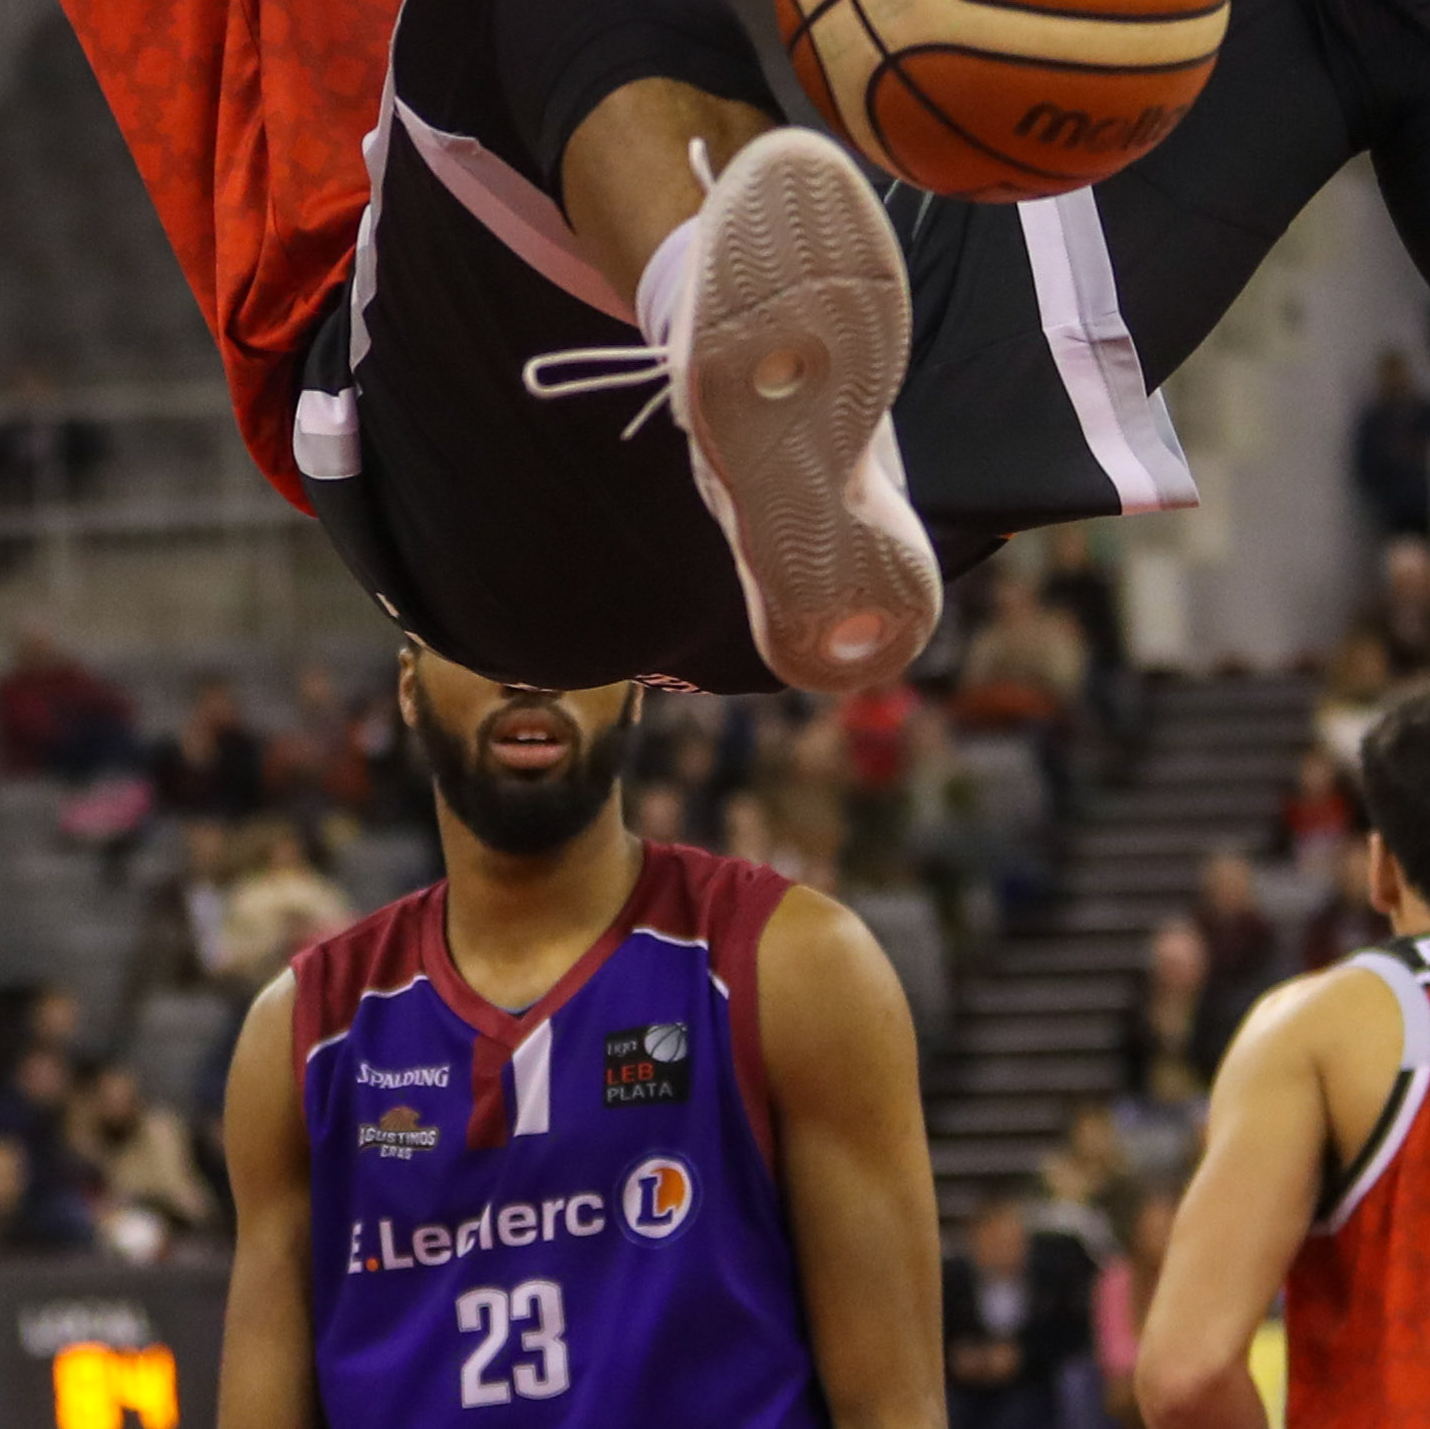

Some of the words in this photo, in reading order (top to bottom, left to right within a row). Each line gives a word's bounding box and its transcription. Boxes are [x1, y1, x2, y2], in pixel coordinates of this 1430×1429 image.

[356, 1063, 450, 1089] SPALDING
[606, 1061, 655, 1085] LEB
[607, 1081, 674, 1103] PLATA
[347, 1192, 606, 1275] E.Leclerc
[455, 1279, 571, 1409] 23
